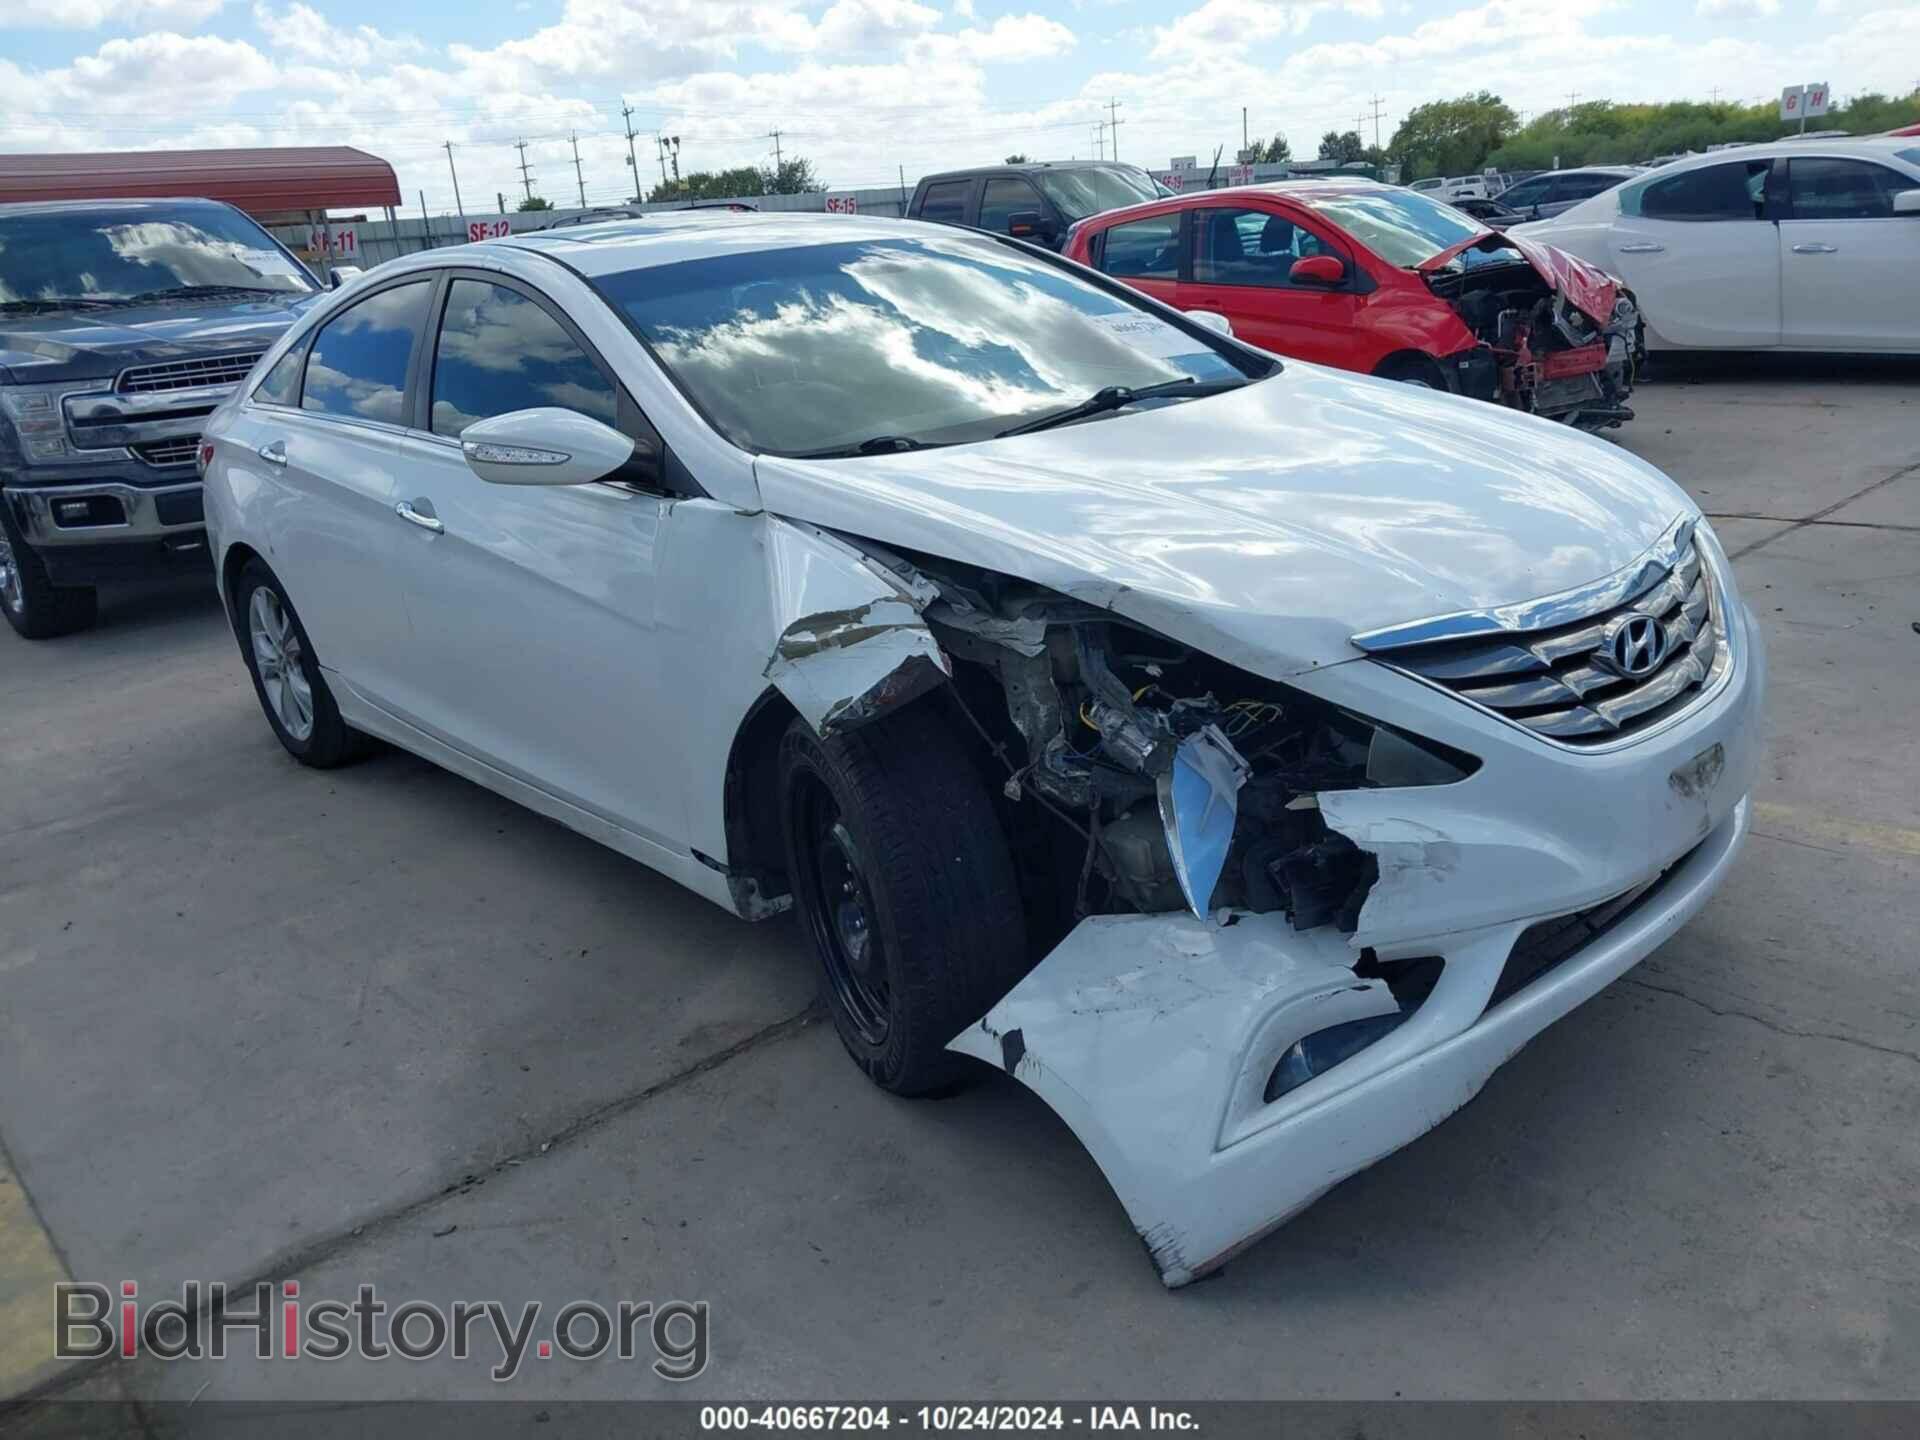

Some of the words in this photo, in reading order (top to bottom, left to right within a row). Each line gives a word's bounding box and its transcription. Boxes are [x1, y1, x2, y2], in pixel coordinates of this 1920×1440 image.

[1786, 95, 1797, 111] G
[1811, 91, 1824, 107] H
[827, 197, 856, 215] SF-15
[470, 221, 509, 242] SF-12
